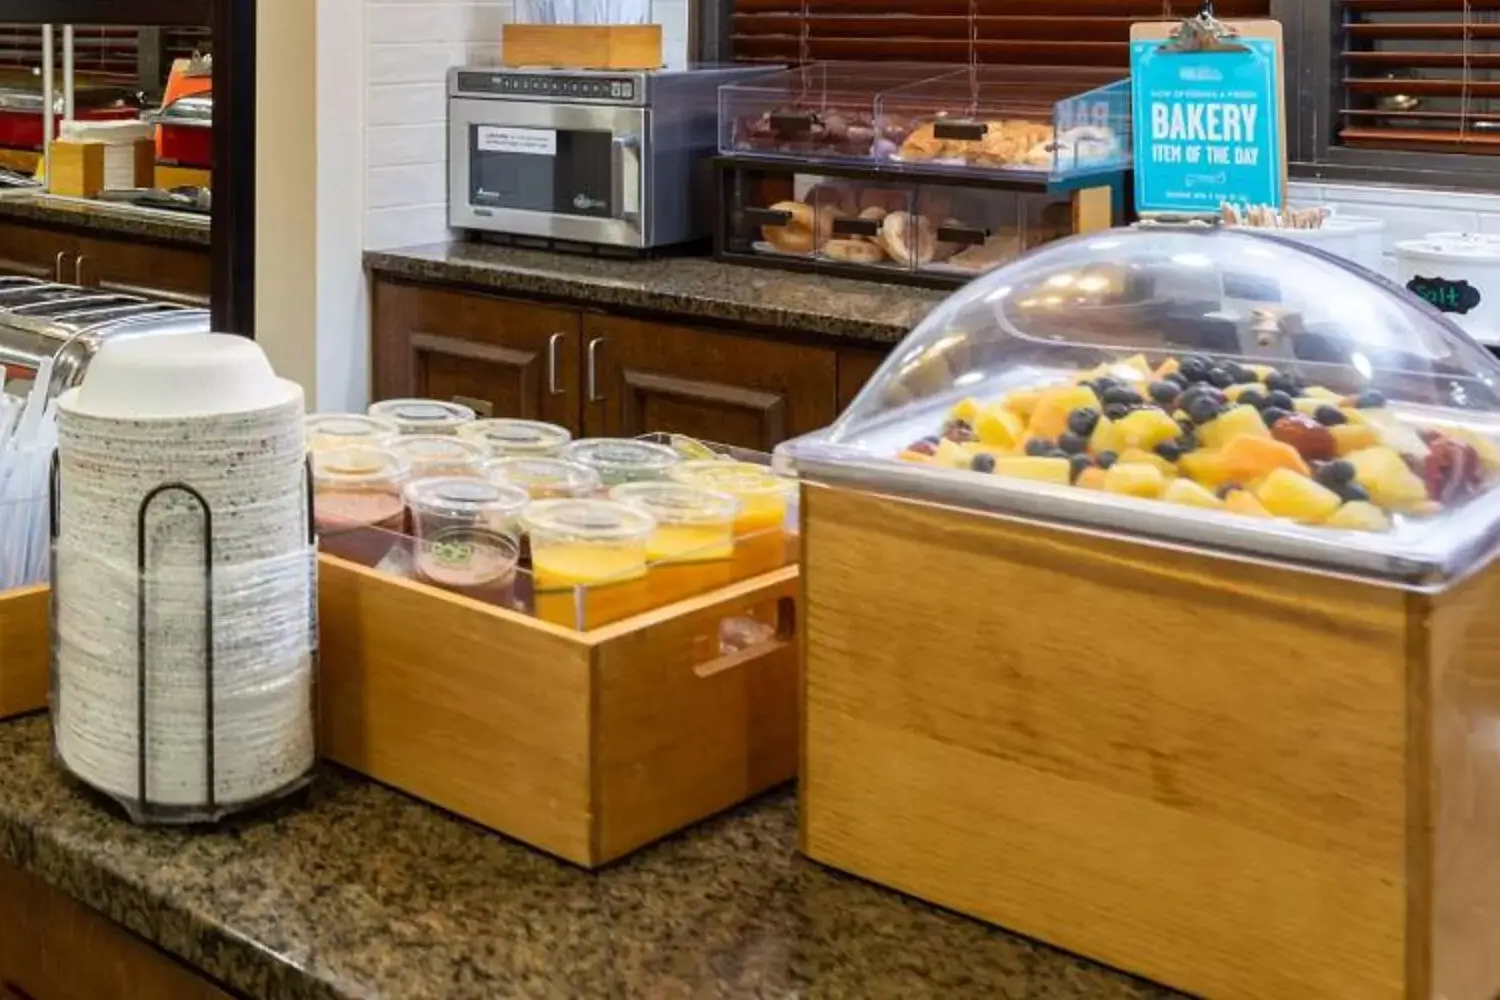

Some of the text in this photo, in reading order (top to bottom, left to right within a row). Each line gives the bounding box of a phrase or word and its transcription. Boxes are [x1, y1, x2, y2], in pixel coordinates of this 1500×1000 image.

[1151, 101, 1258, 142] BAKERY
[1152, 144, 1259, 166] ITEM OF THE DAY
